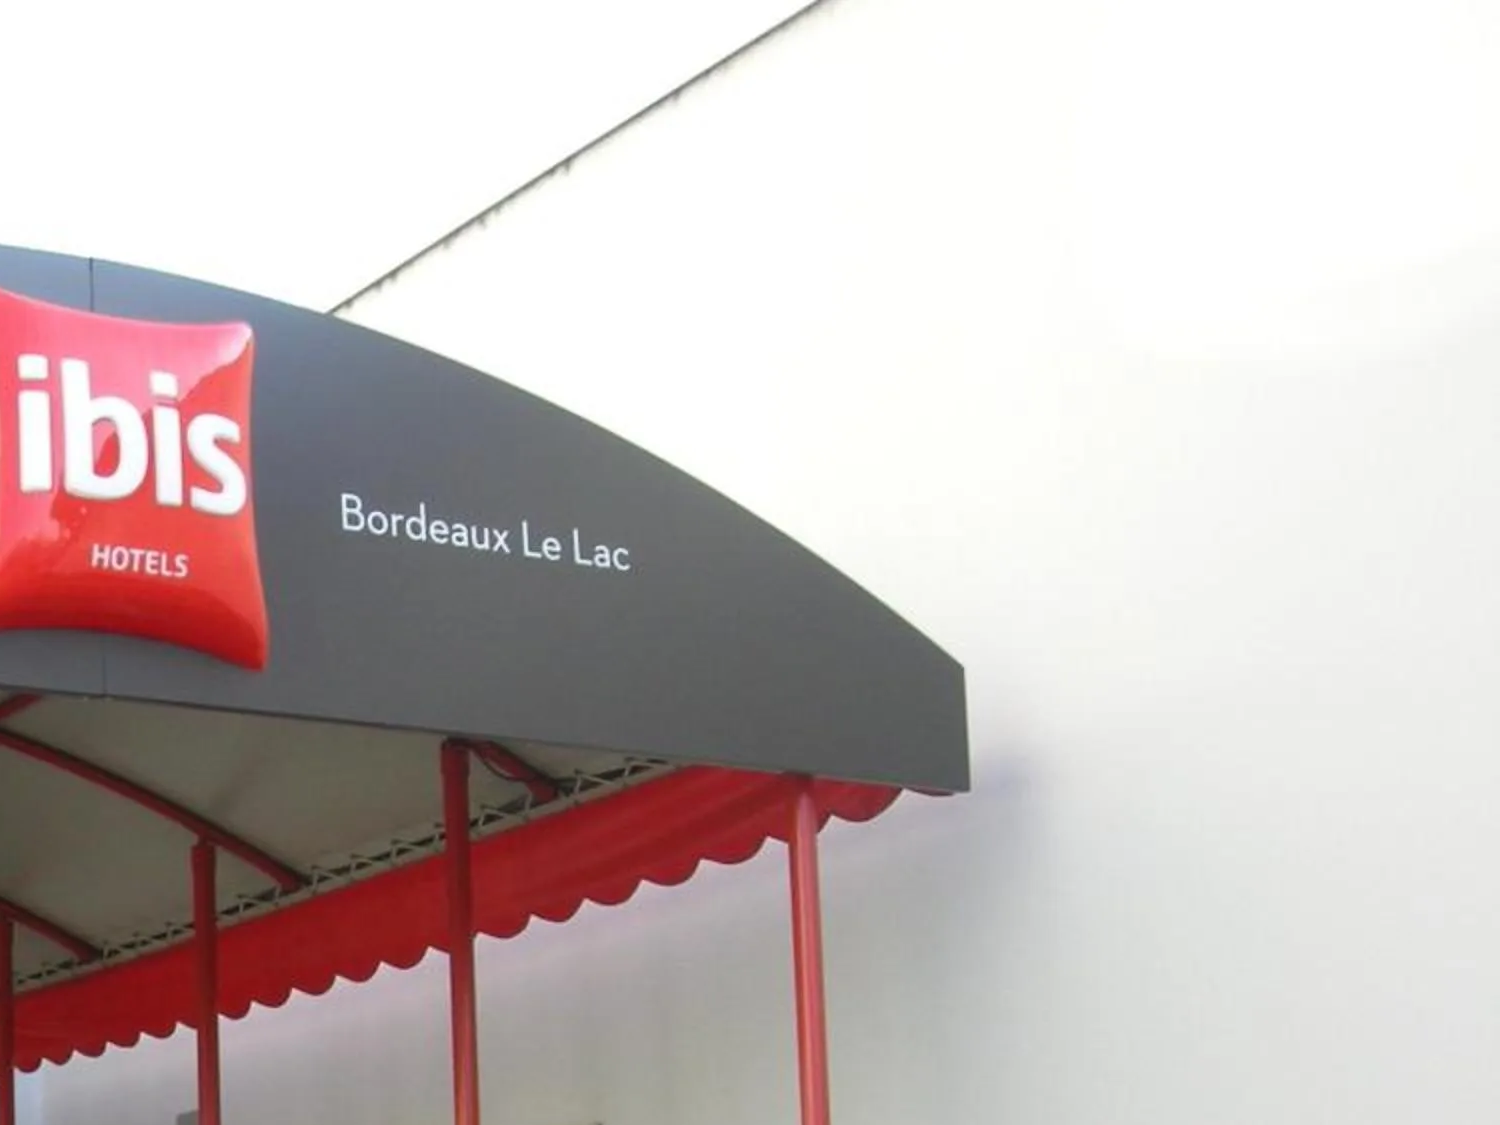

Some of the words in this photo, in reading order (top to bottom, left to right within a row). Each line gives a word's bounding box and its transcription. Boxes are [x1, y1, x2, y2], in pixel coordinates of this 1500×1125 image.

[16, 352, 248, 517] ibis
[90, 543, 190, 578] HOTELS
[340, 492, 512, 555] Bordeaux
[521, 519, 563, 562] Le
[571, 527, 632, 572] Lac
